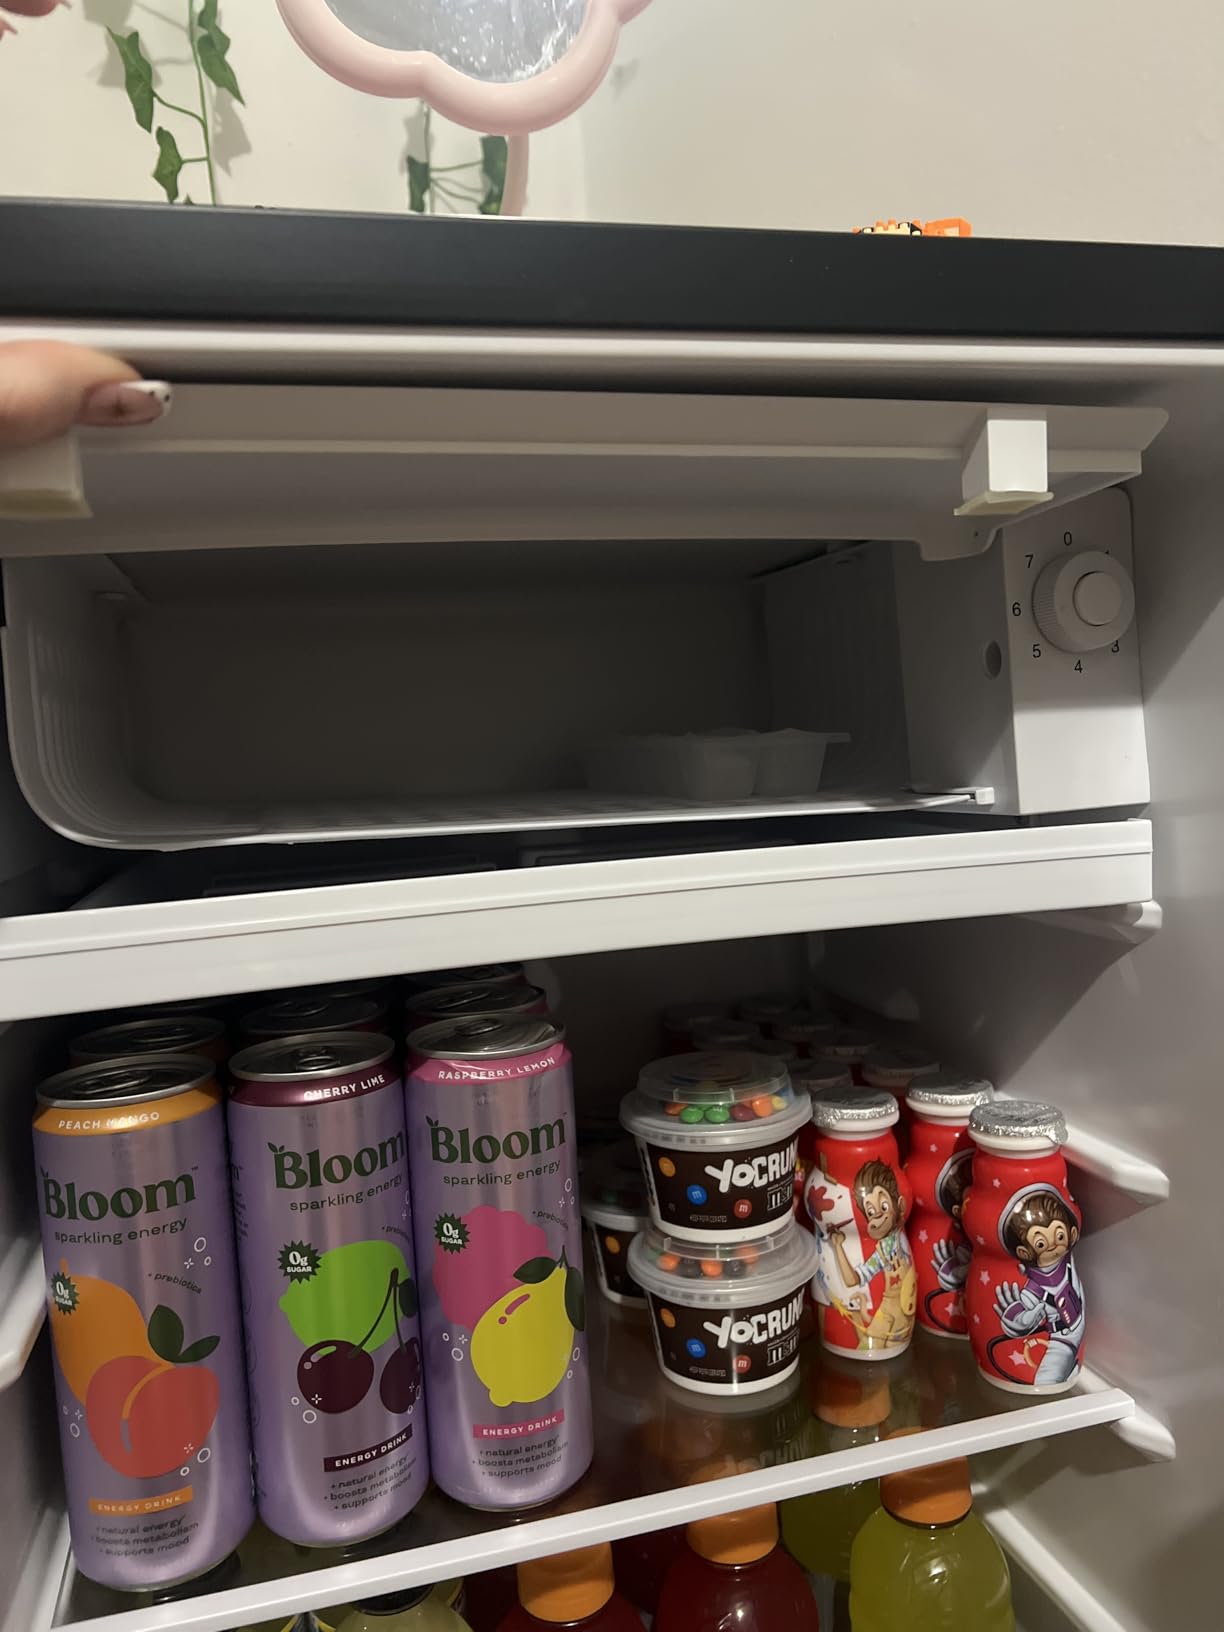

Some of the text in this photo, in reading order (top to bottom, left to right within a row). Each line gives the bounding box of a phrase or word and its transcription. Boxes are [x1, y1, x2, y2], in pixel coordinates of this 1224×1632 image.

[1063, 531, 1073, 546] 0
[1025, 554, 1034, 568] 7
[1012, 602, 1022, 616] 6
[1032, 643, 1041, 658] 5
[1074, 659, 1083, 673] 4
[438, 1056, 556, 1080] RASPBERRY LEMON
[303, 1074, 385, 1099] CHERRY LIME
[58, 1119, 101, 1130] PEACH
[430, 1118, 566, 1164] Bloom
[273, 1131, 406, 1190] Bloom
[443, 1160, 561, 1187] sparkling energy
[44, 1173, 196, 1222] Bloom
[289, 1190, 364, 1213] sparkling
[54, 1217, 188, 1246] sparkling energy
[442, 1222, 459, 1239] 0g
[441, 1236, 462, 1246] SUGAR
[288, 1251, 308, 1267] 0g
[286, 1265, 312, 1273] SUGAR
[483, 1416, 557, 1436] ENERGY DRINK
[335, 1433, 407, 1467] ENERGY DRINK
[486, 1446, 522, 1456] natural
[488, 1456, 562, 1477] supports mood
[338, 1472, 376, 1489] natural
[330, 1488, 367, 1500] boosts
[342, 1490, 388, 1510] supports
[98, 1504, 139, 1512] ENERGY
[157, 1536, 190, 1551] mood
